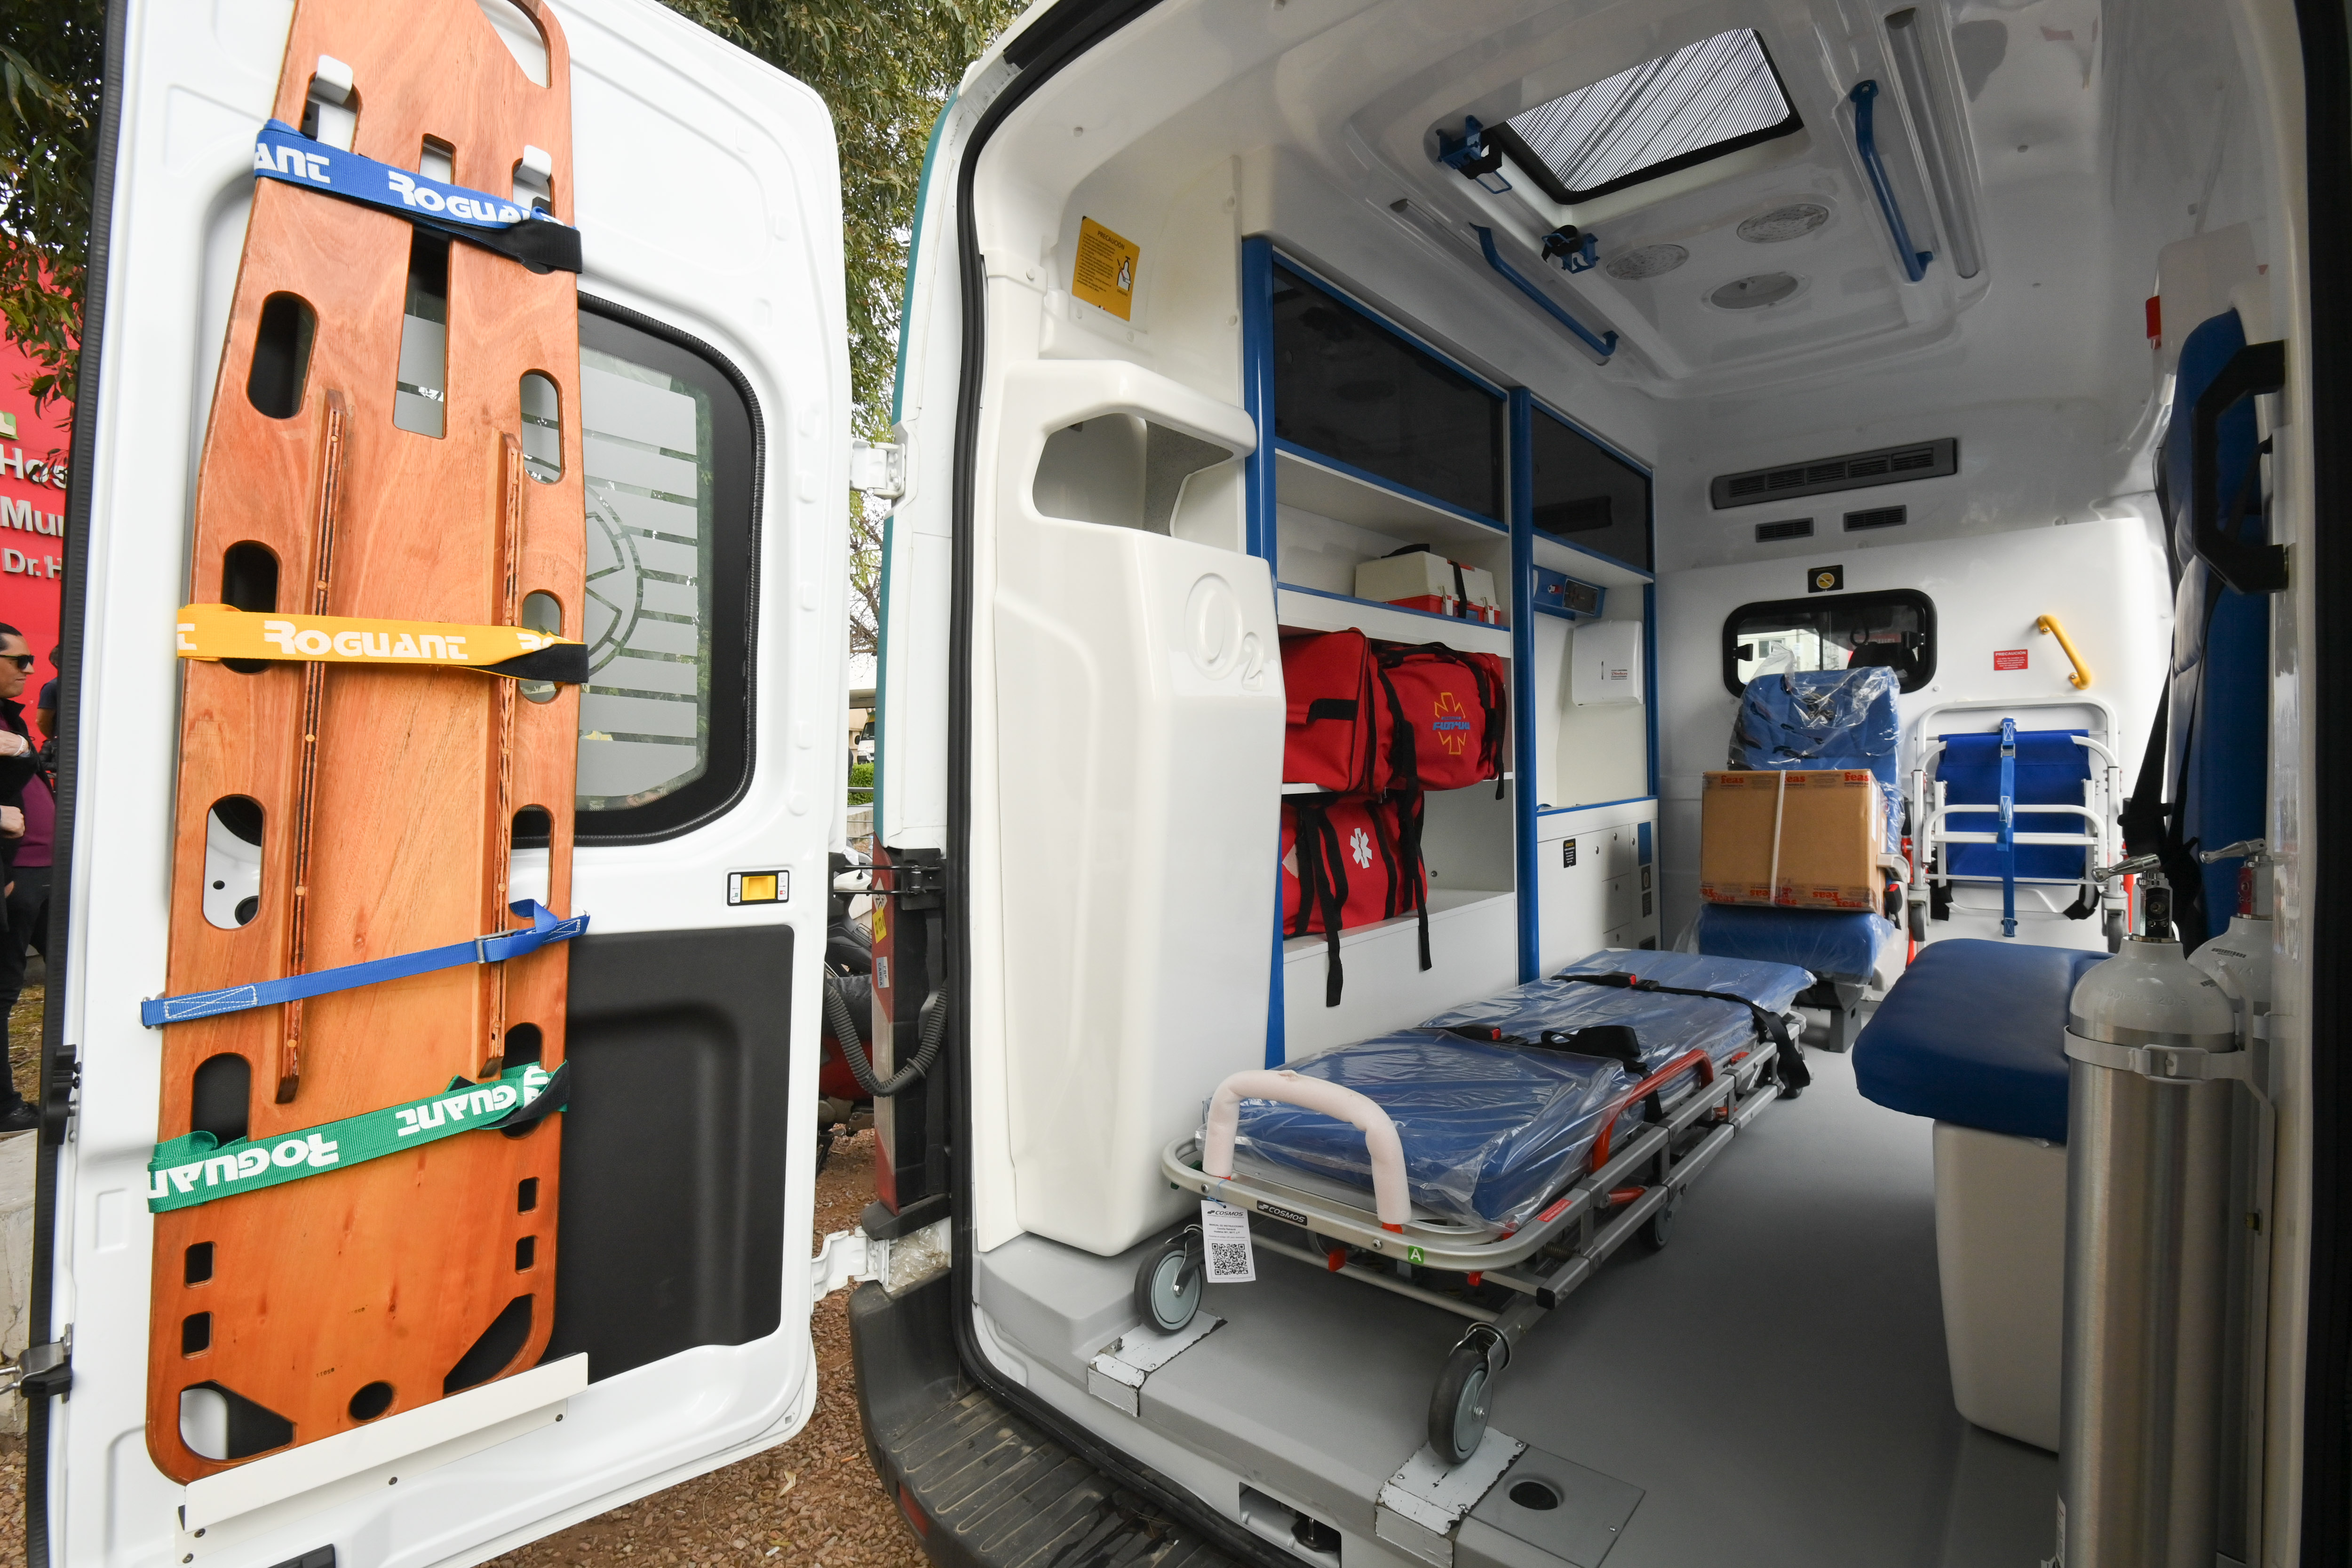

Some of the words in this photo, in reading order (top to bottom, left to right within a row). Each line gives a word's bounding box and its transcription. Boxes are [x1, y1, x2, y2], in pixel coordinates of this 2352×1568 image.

[1097, 230, 1125, 250] PRECAUCIÓN
[2, 547, 41, 577] Dr.
[263, 619, 469, 660] ROGUANT
[1721, 775, 1744, 784] feas
[1844, 772, 1869, 781] feas
[1269, 1207, 1305, 1223] COSMOS
[1410, 1249, 1422, 1261] A
